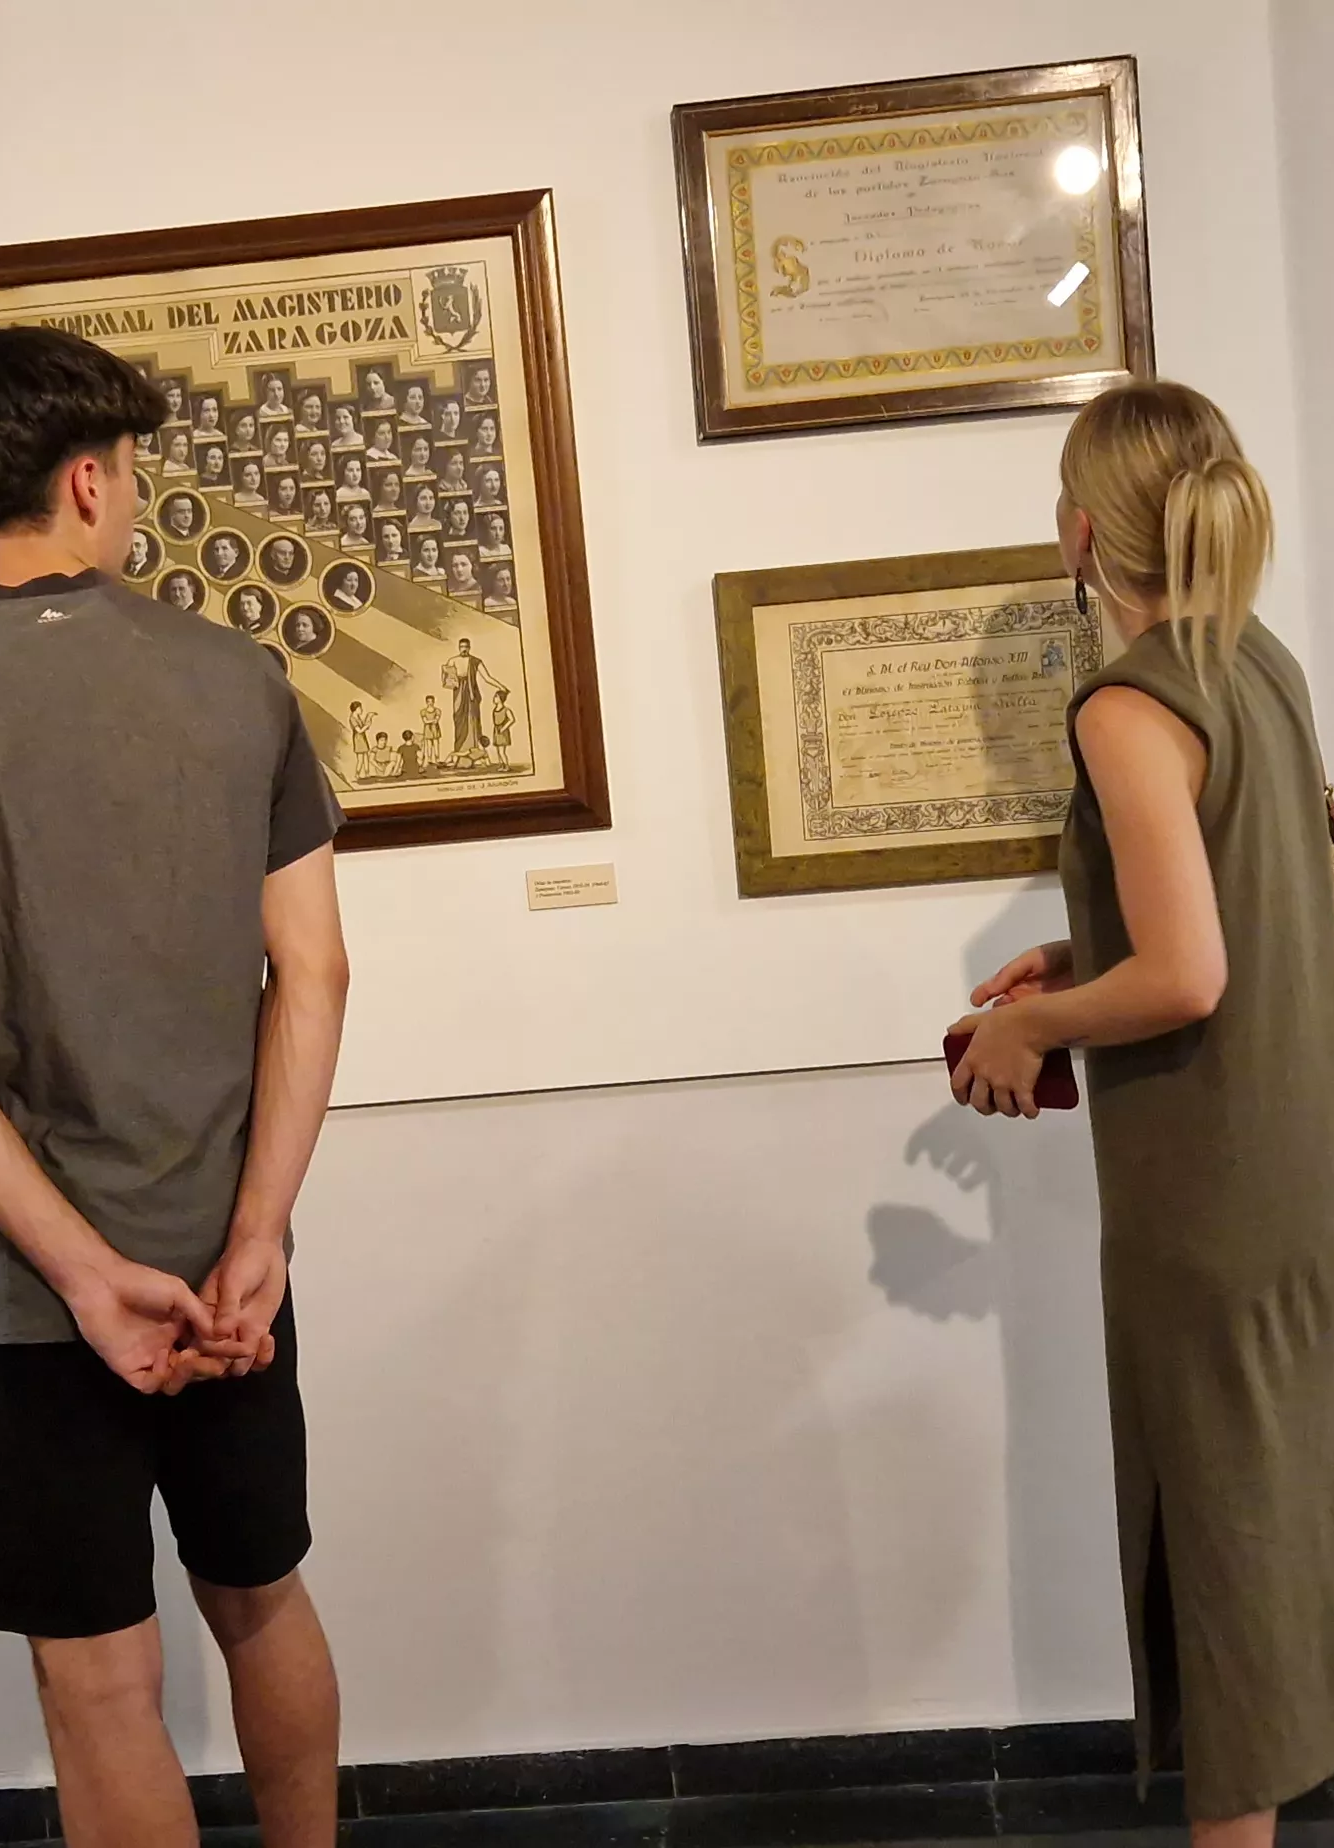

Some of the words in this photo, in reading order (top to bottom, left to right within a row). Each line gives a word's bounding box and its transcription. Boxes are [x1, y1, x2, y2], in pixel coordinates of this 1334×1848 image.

[854, 247, 925, 265] Diploma
[167, 302, 219, 329] DEL
[233, 283, 402, 323] MAGISTERIO
[223, 315, 409, 355] ZARAGOZA
[934, 658, 957, 670] Don
[961, 655, 1005, 668] Alfonso
